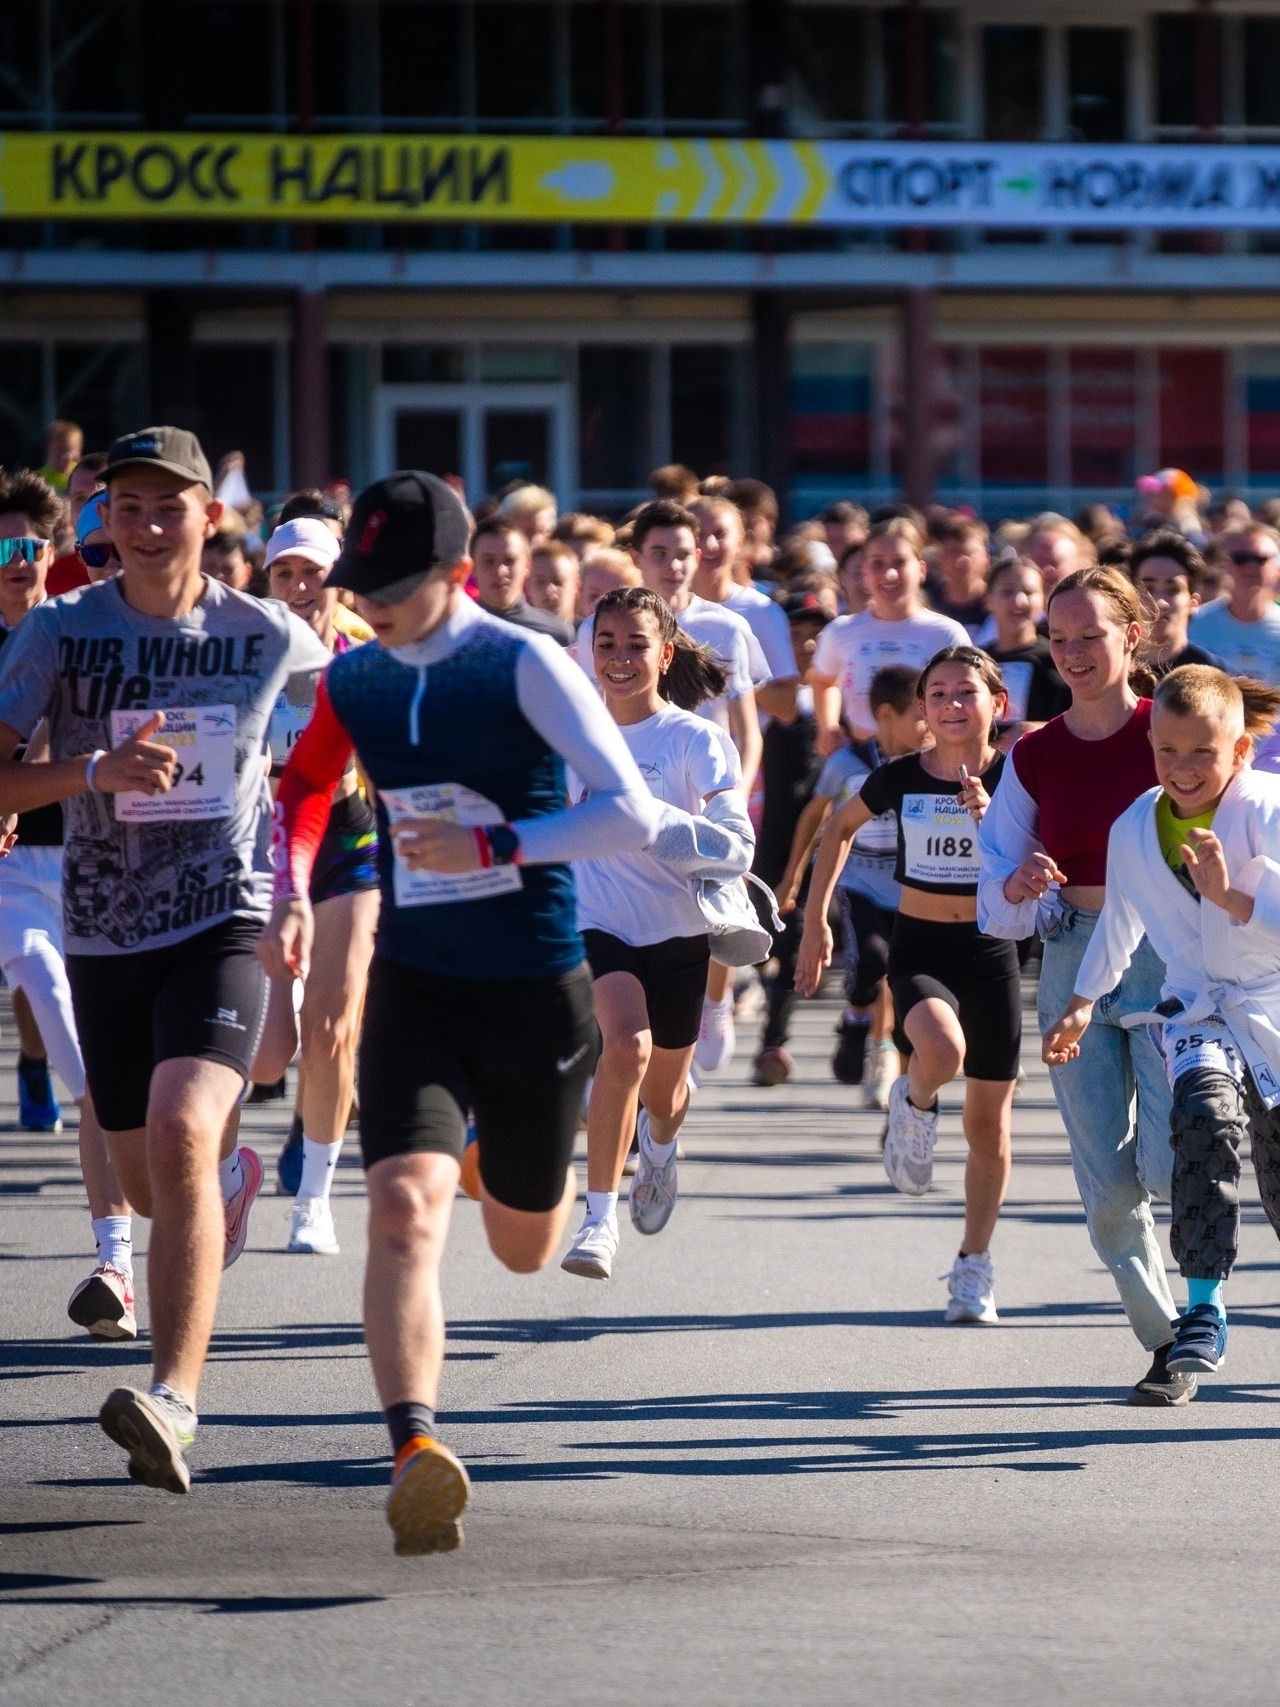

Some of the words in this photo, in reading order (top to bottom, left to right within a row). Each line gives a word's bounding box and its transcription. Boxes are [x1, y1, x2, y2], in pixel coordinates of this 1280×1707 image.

[52, 143, 241, 202] КРОСС
[268, 145, 512, 208] НАЦИИ
[840, 157, 997, 208] СПОРТ
[1047, 159, 1233, 209] НОРМА
[137, 634, 265, 677] WHOLE
[68, 664, 152, 719] Life
[158, 722, 198, 733] АЦИИ
[934, 805, 968, 815] НАЦИИ
[935, 797, 957, 805] КРОС
[935, 815, 967, 826] 2023
[927, 836, 974, 858] 1182
